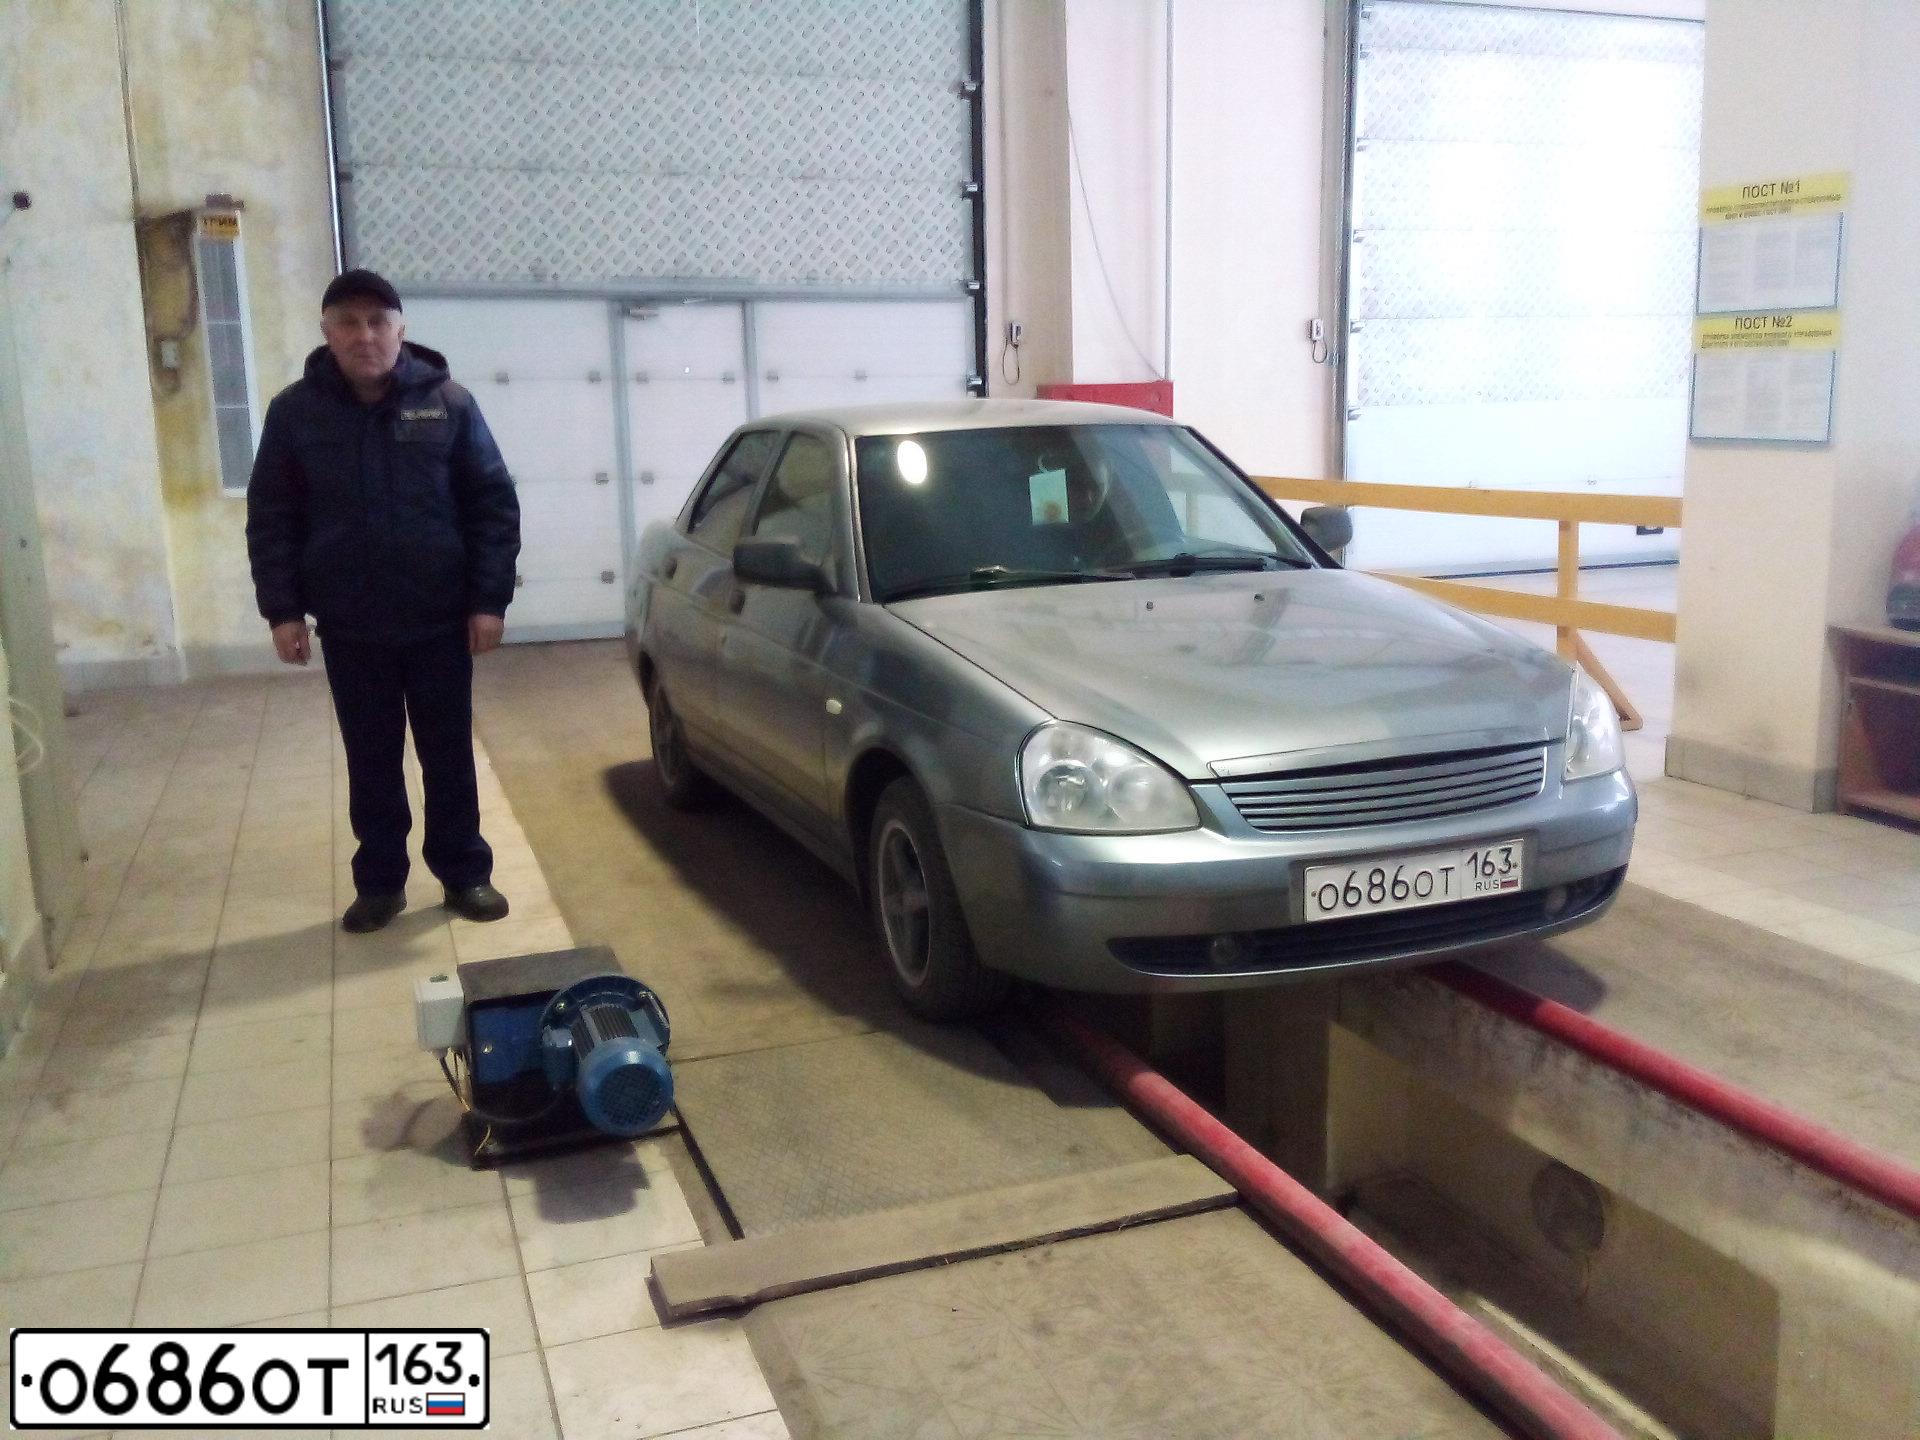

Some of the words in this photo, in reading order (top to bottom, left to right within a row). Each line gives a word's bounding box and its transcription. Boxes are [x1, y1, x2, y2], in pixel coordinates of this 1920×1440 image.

[1742, 184, 1776, 199] ПОСТ
[1780, 180, 1801, 195] №1
[1735, 316, 1768, 330] ПОСТ
[1772, 316, 1793, 328] №2
[1466, 846, 1513, 878] 163
[1475, 880, 1500, 891] RUS
